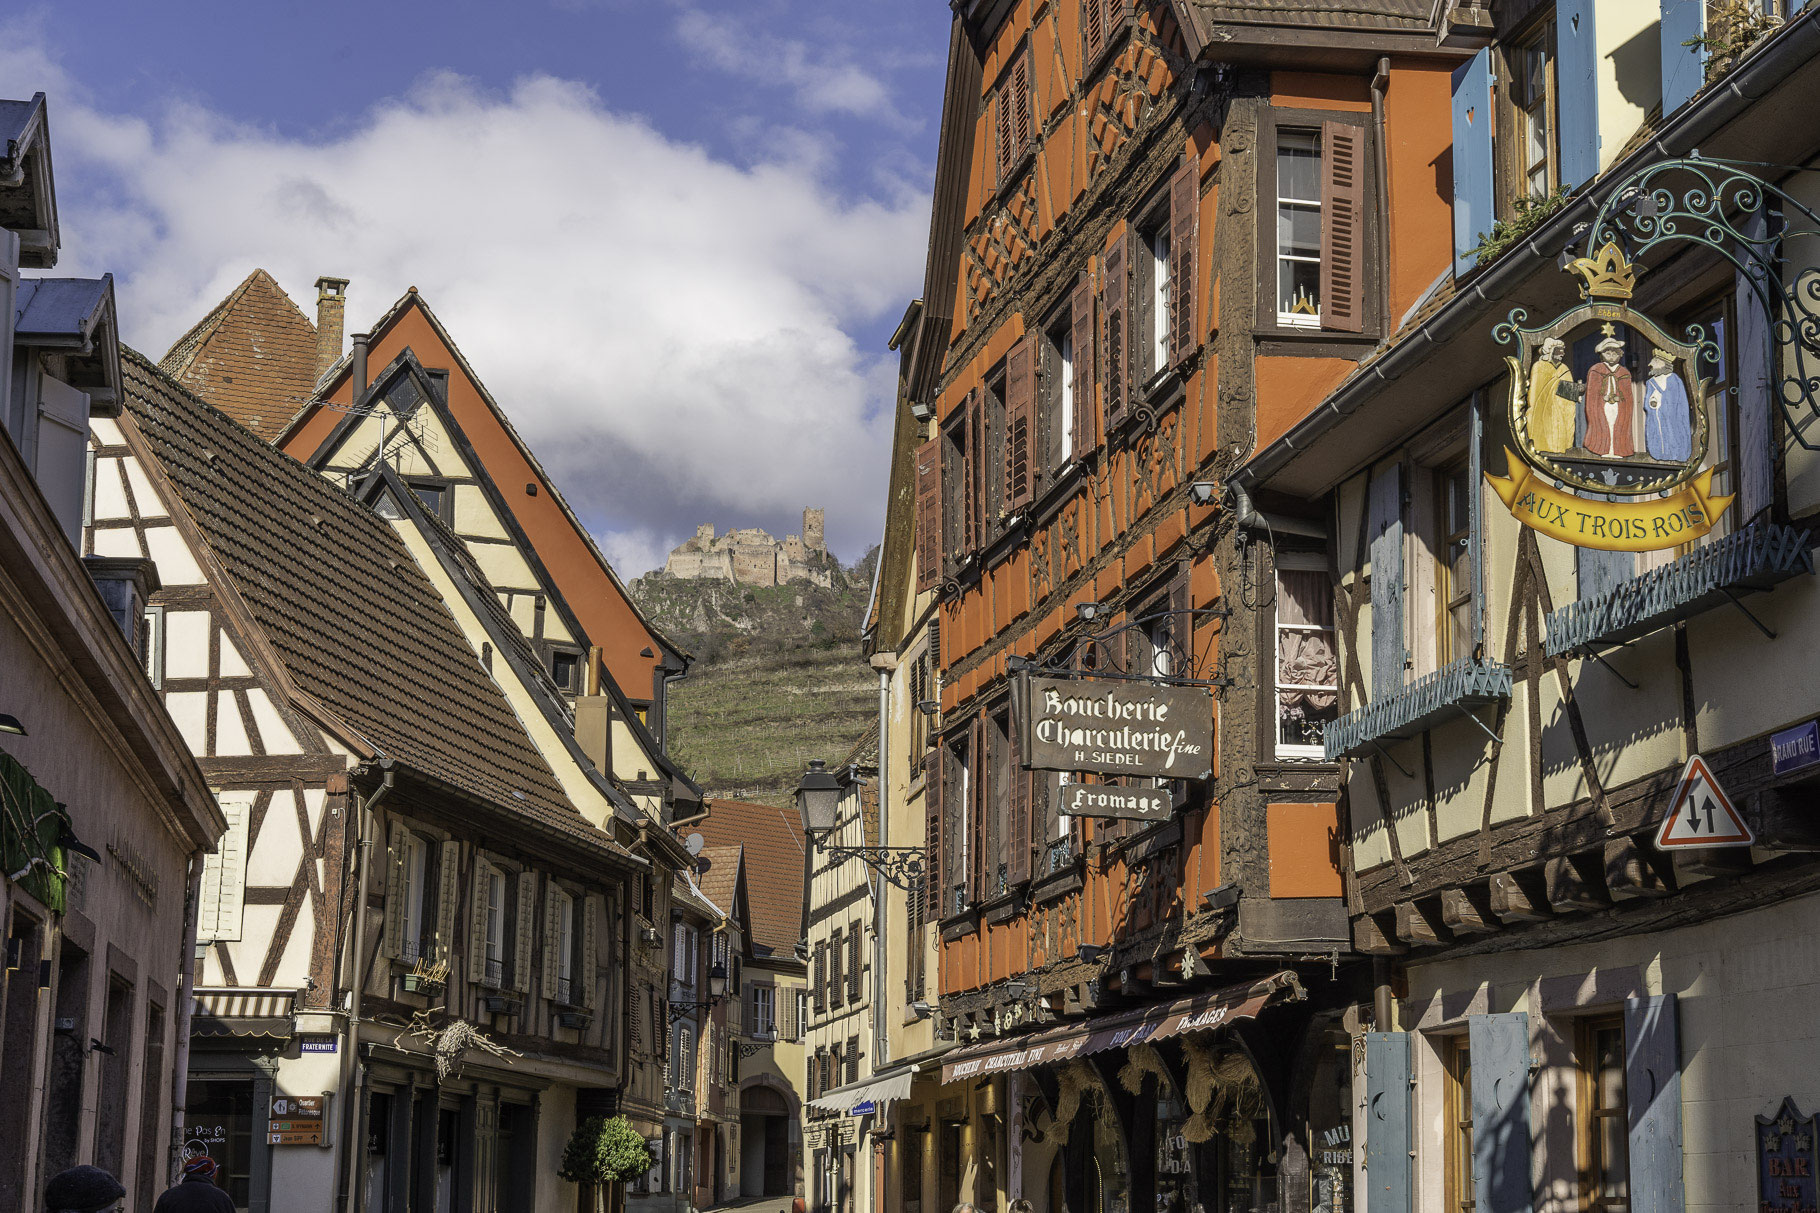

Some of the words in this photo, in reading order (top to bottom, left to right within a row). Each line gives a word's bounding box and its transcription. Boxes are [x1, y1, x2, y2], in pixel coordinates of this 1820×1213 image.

[1516, 491, 1570, 529] AUX
[1576, 511, 1647, 539] TROIS
[1653, 502, 1705, 538] ROIS
[1042, 687, 1168, 722] Boucherie
[1036, 717, 1172, 752] Charcuterie
[1164, 729, 1201, 769] fine
[1075, 750, 1089, 762] H.
[1092, 752, 1143, 766] SIEDEL
[1071, 788, 1161, 813] Fromage
[952, 1059, 982, 1077] BOUCHERIE
[984, 1050, 1027, 1070] CHARCUTERIE
[1176, 1007, 1228, 1031] FROMAGES
[1768, 1157, 1810, 1177] BAR
